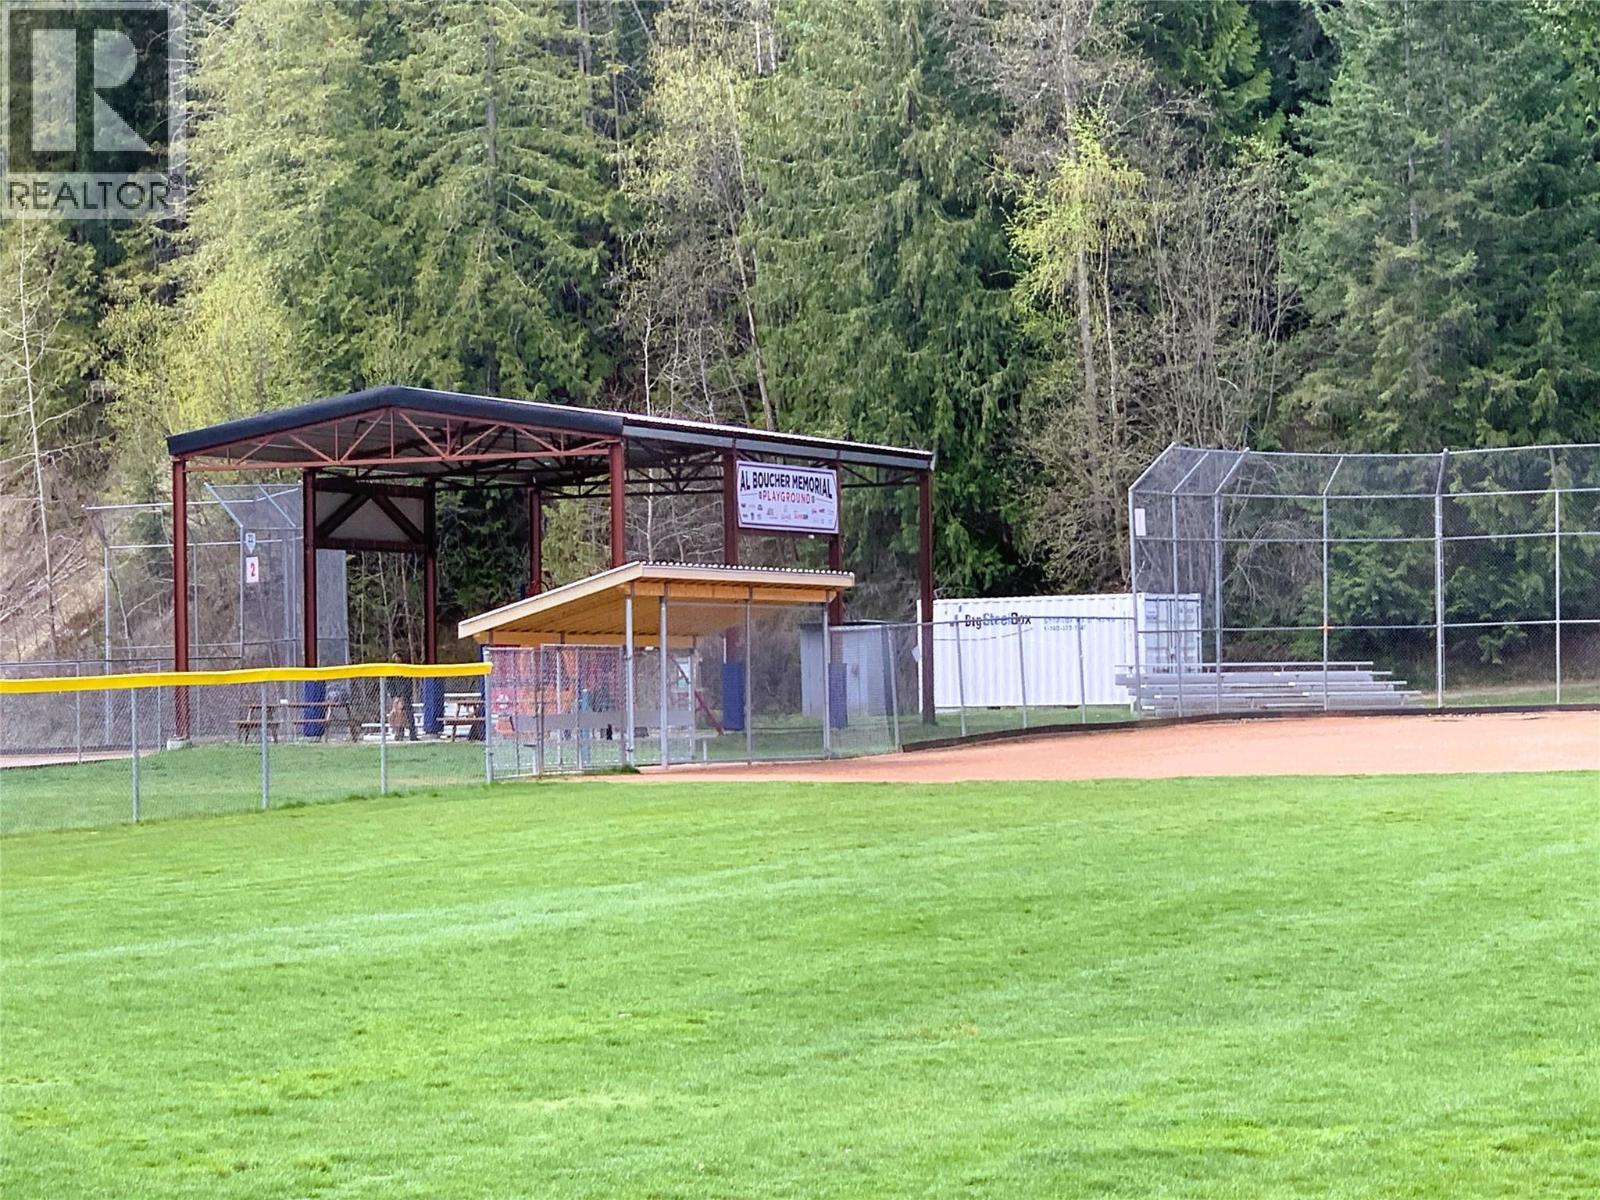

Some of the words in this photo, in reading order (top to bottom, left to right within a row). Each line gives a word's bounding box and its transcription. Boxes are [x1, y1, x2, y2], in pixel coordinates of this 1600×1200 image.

[740, 470, 751, 491] AL
[753, 472, 791, 489] BOUCHER
[792, 474, 833, 499] MEMORIAL
[763, 490, 810, 504] PLAYGROUND
[250, 562, 256, 577] 2
